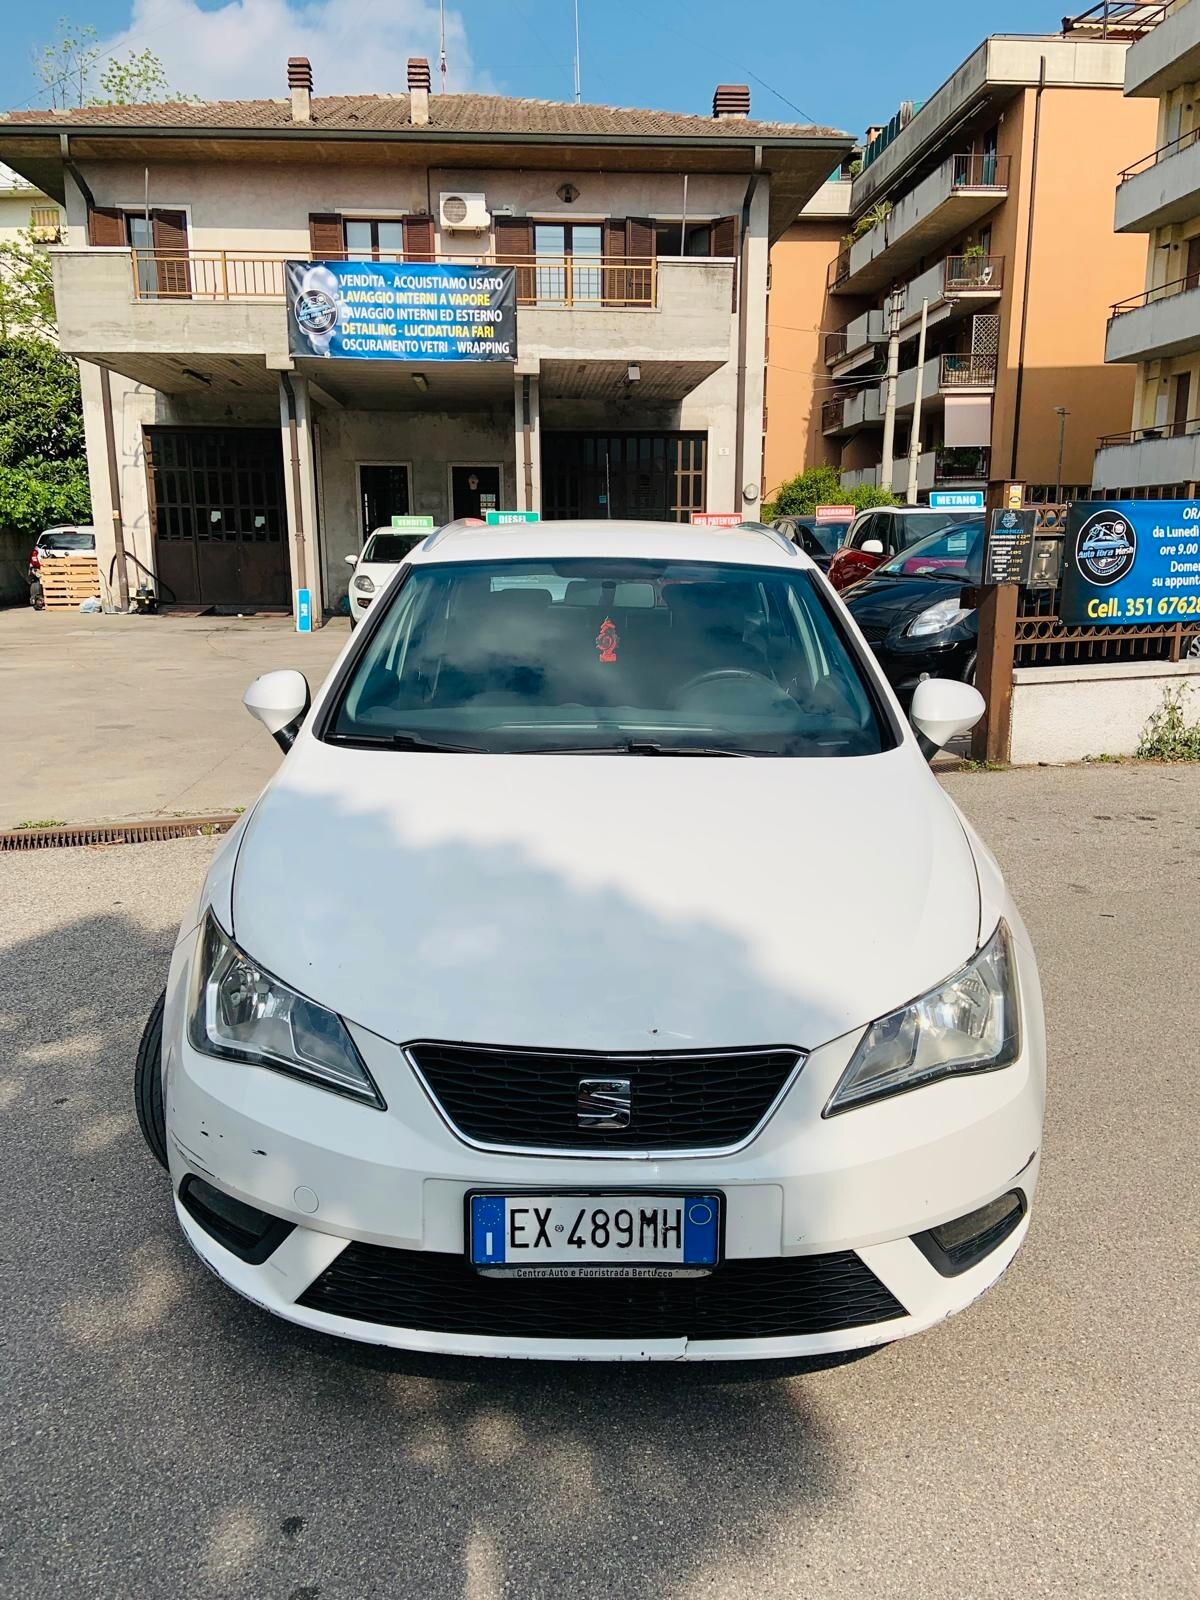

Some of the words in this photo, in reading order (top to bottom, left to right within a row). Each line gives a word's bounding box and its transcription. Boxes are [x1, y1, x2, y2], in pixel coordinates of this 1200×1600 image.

[339, 274, 386, 289] VENDITA
[393, 275, 467, 290] ACQUISTIAMO
[468, 277, 504, 291] USATO
[339, 291, 394, 304] LAVAGGIO
[395, 292, 436, 305] INTERNI
[439, 293, 448, 305] A
[449, 294, 490, 305] VAPORE
[341, 307, 394, 321] LAVAGGIO
[395, 308, 439, 321] INTERNI
[440, 309, 454, 322] ED
[455, 310, 503, 323] ESTERNO
[341, 322, 397, 336] DETAILING
[404, 324, 470, 337] LUCIDATURA
[471, 326, 495, 338] FARI
[342, 339, 419, 352] OSCURAMENTO
[420, 341, 448, 353] VETRI
[457, 341, 510, 354] WRAPPING
[936, 495, 977, 505] METANO
[498, 514, 527, 524] DIESEL
[1152, 525, 1165, 538] da
[1166, 525, 1200, 538] Lunedì
[1160, 545, 1176, 556] ore
[1177, 543, 1198, 555] 9.00
[1170, 560, 1200, 573] Dome
[1152, 577, 1163, 587] su
[1164, 575, 1200, 589] appunt
[1087, 597, 1122, 619] Cell.
[1125, 597, 1153, 618] 351
[509, 1207, 552, 1249] EX
[566, 1207, 683, 1250] 489MH
[516, 1269, 546, 1278] Centro
[548, 1269, 569, 1278] Auto
[578, 1268, 630, 1278] Fuoristrada
